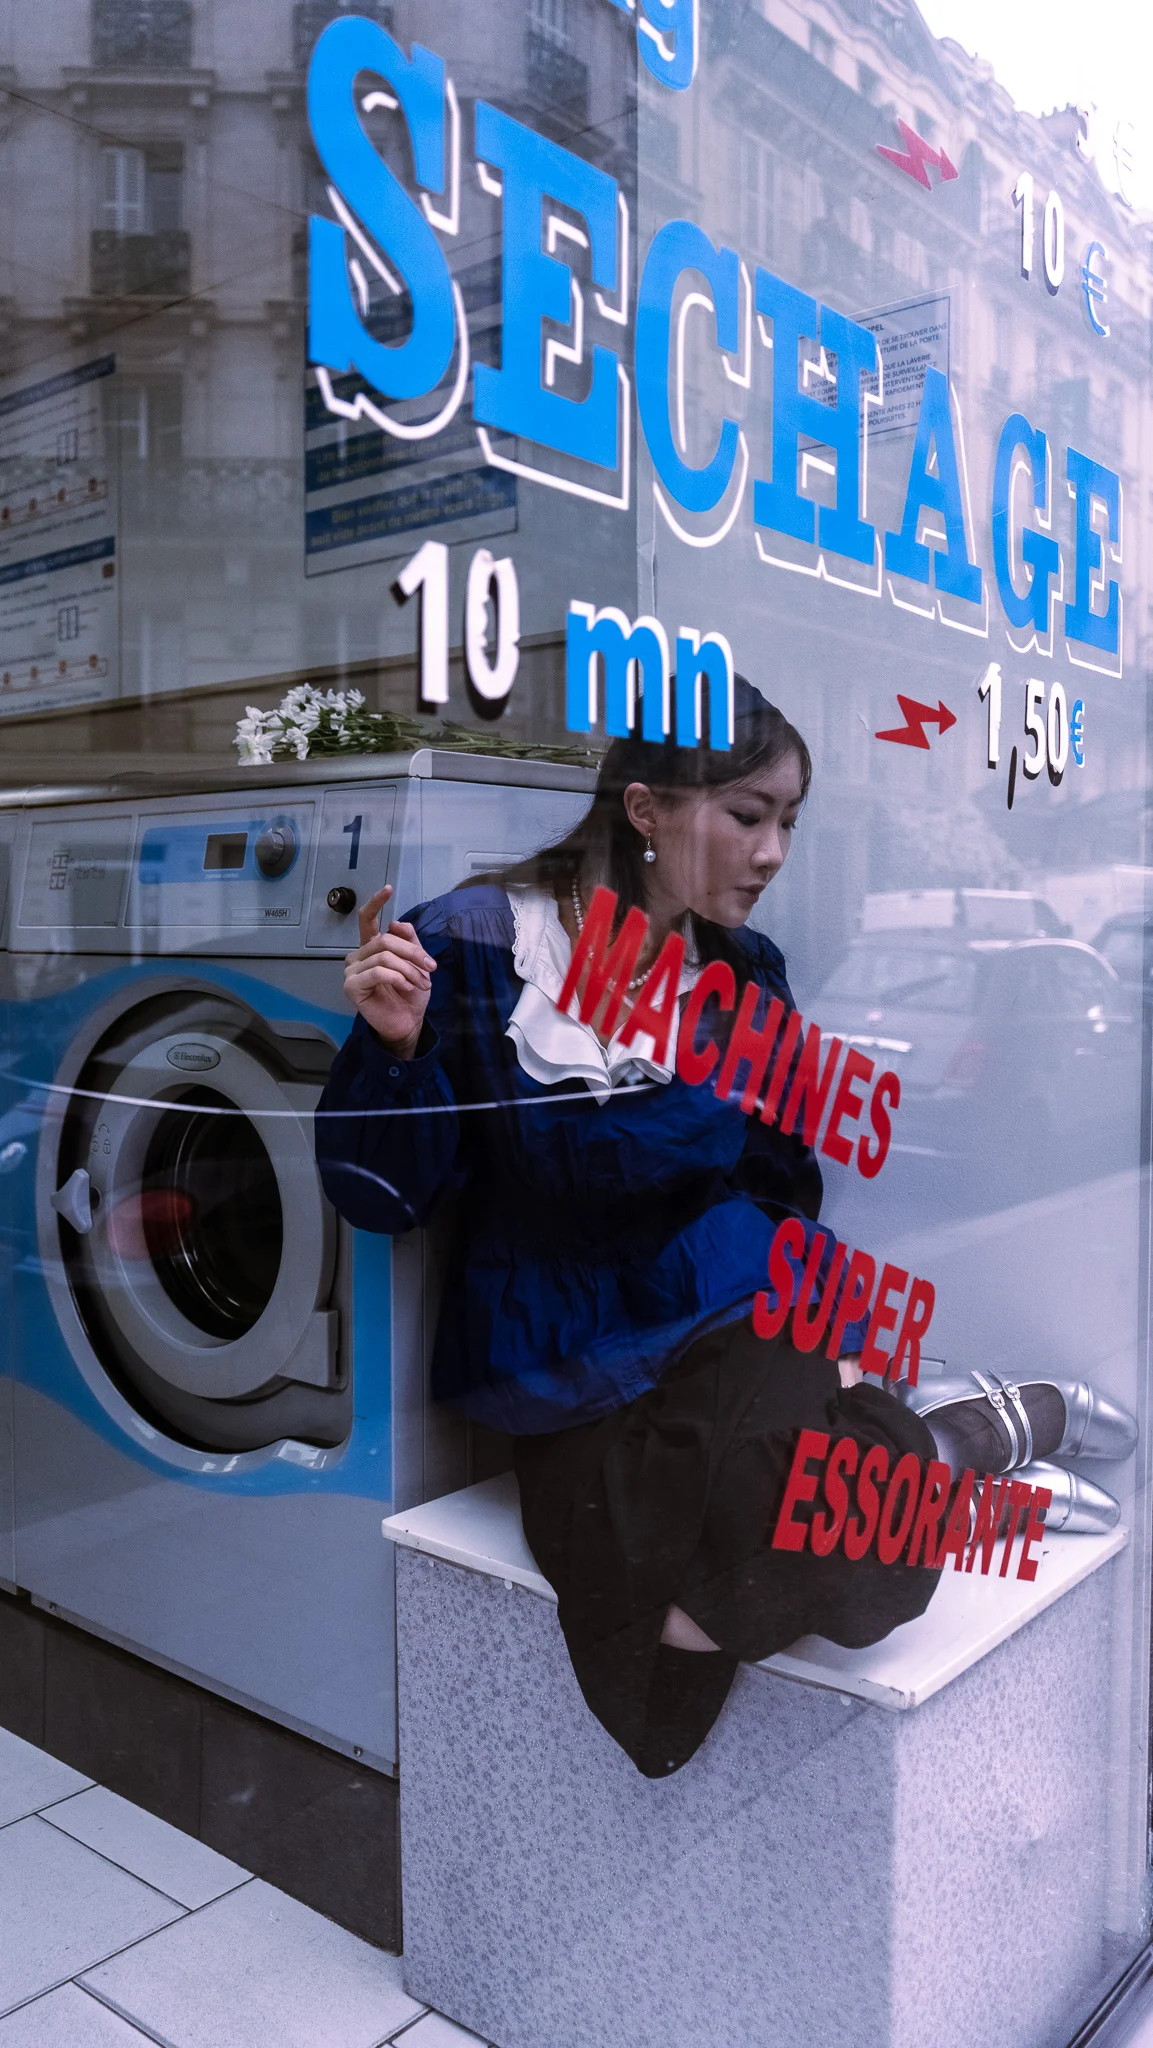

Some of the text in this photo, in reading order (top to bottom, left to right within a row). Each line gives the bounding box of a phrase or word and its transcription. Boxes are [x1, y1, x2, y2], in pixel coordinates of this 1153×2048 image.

[608, 0, 700, 91] g
[1011, 171, 1111, 338] 10 €
[308, 15, 1123, 678] SECHAGE
[900, 327, 929, 340] TROUVER
[928, 322, 948, 333] DANS
[906, 353, 931, 365] LAVERIE
[883, 373, 926, 388] NTERVENTION
[390, 540, 735, 751] 10 mn
[343, 814, 363, 870] 1
[264, 908, 288, 918] W465H
[181, 1051, 212, 1063] Electrolux
[555, 885, 901, 1179] MACHINES
[752, 1217, 937, 1388] SUPER
[771, 1428, 1054, 1582] ESSORANTE
